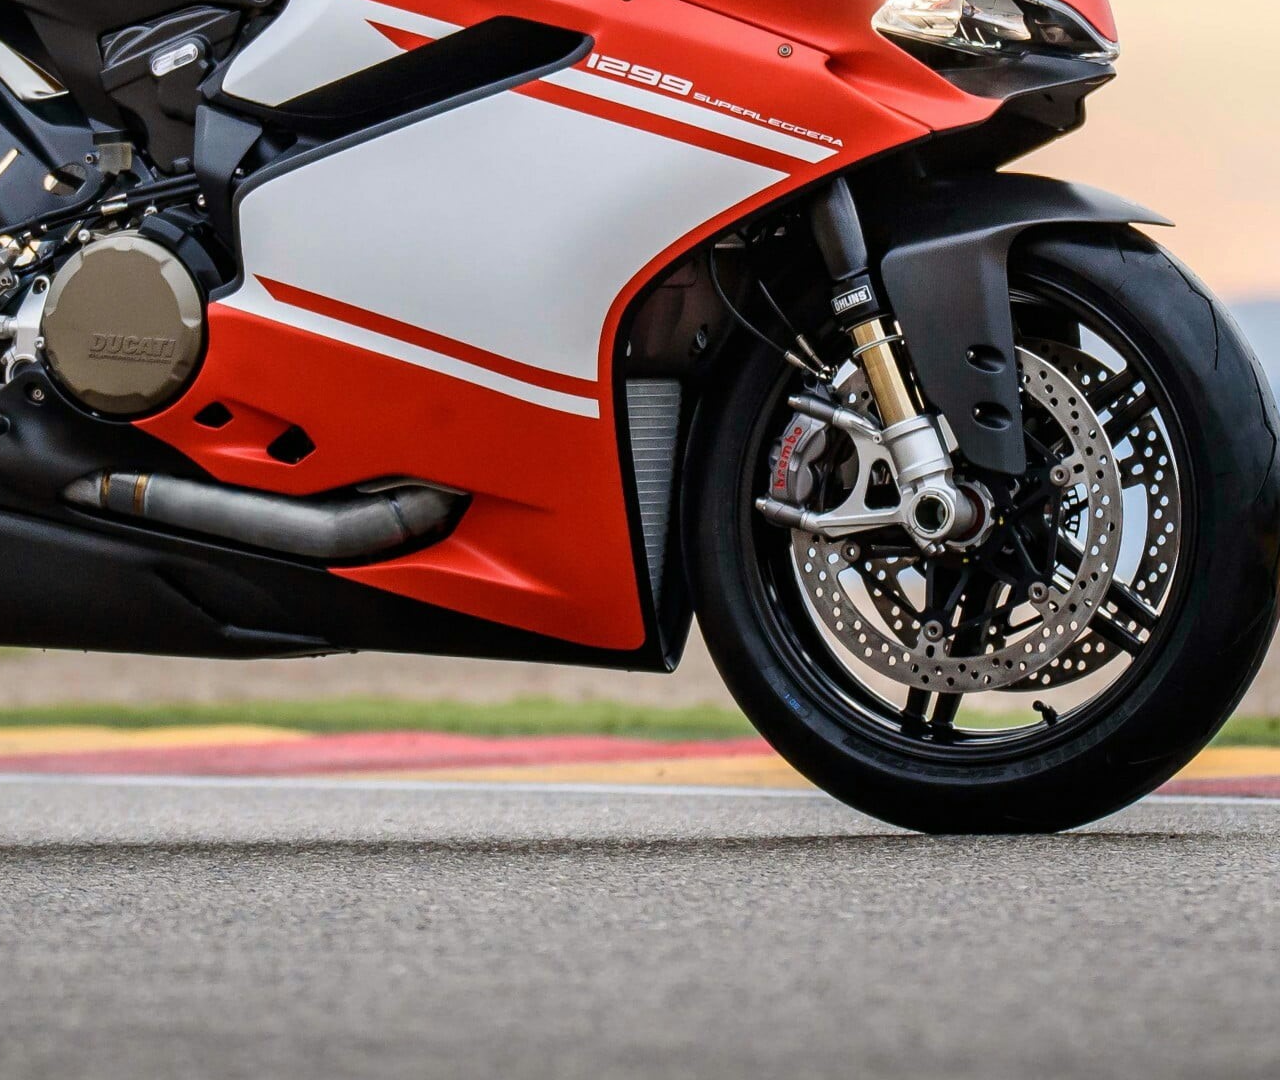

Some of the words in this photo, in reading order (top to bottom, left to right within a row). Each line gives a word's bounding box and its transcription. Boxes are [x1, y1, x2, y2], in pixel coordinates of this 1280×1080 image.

[586, 53, 694, 96] 1299
[693, 92, 844, 147] SUPERLEGGERA
[89, 333, 177, 358] DUCATI
[774, 427, 803, 489] brembo
